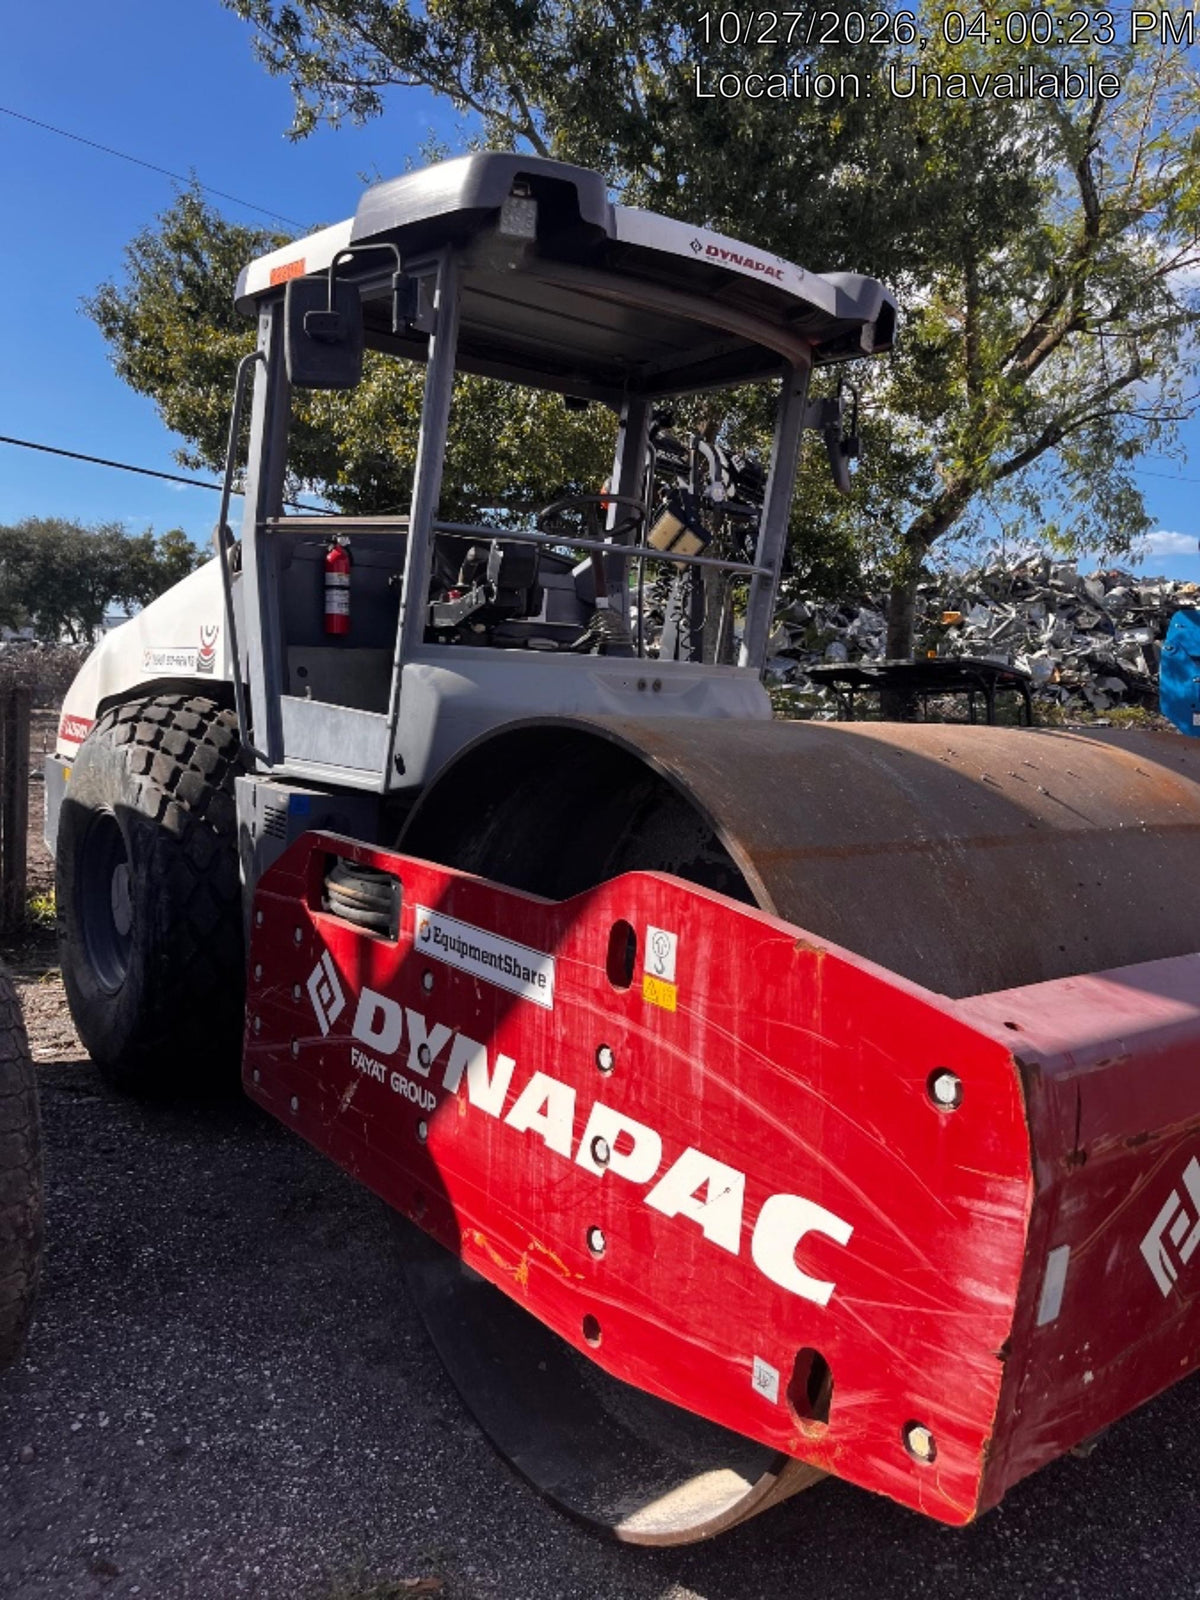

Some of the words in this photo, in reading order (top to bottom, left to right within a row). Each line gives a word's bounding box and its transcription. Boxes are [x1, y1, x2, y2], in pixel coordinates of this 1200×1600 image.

[705, 244, 785, 281] DYNAPAC
[433, 925, 547, 988] EquipmentShare
[351, 1046, 387, 1084] FAYAT
[390, 1071, 437, 1112] GROUP
[352, 986, 854, 1307] DYNAPAC
